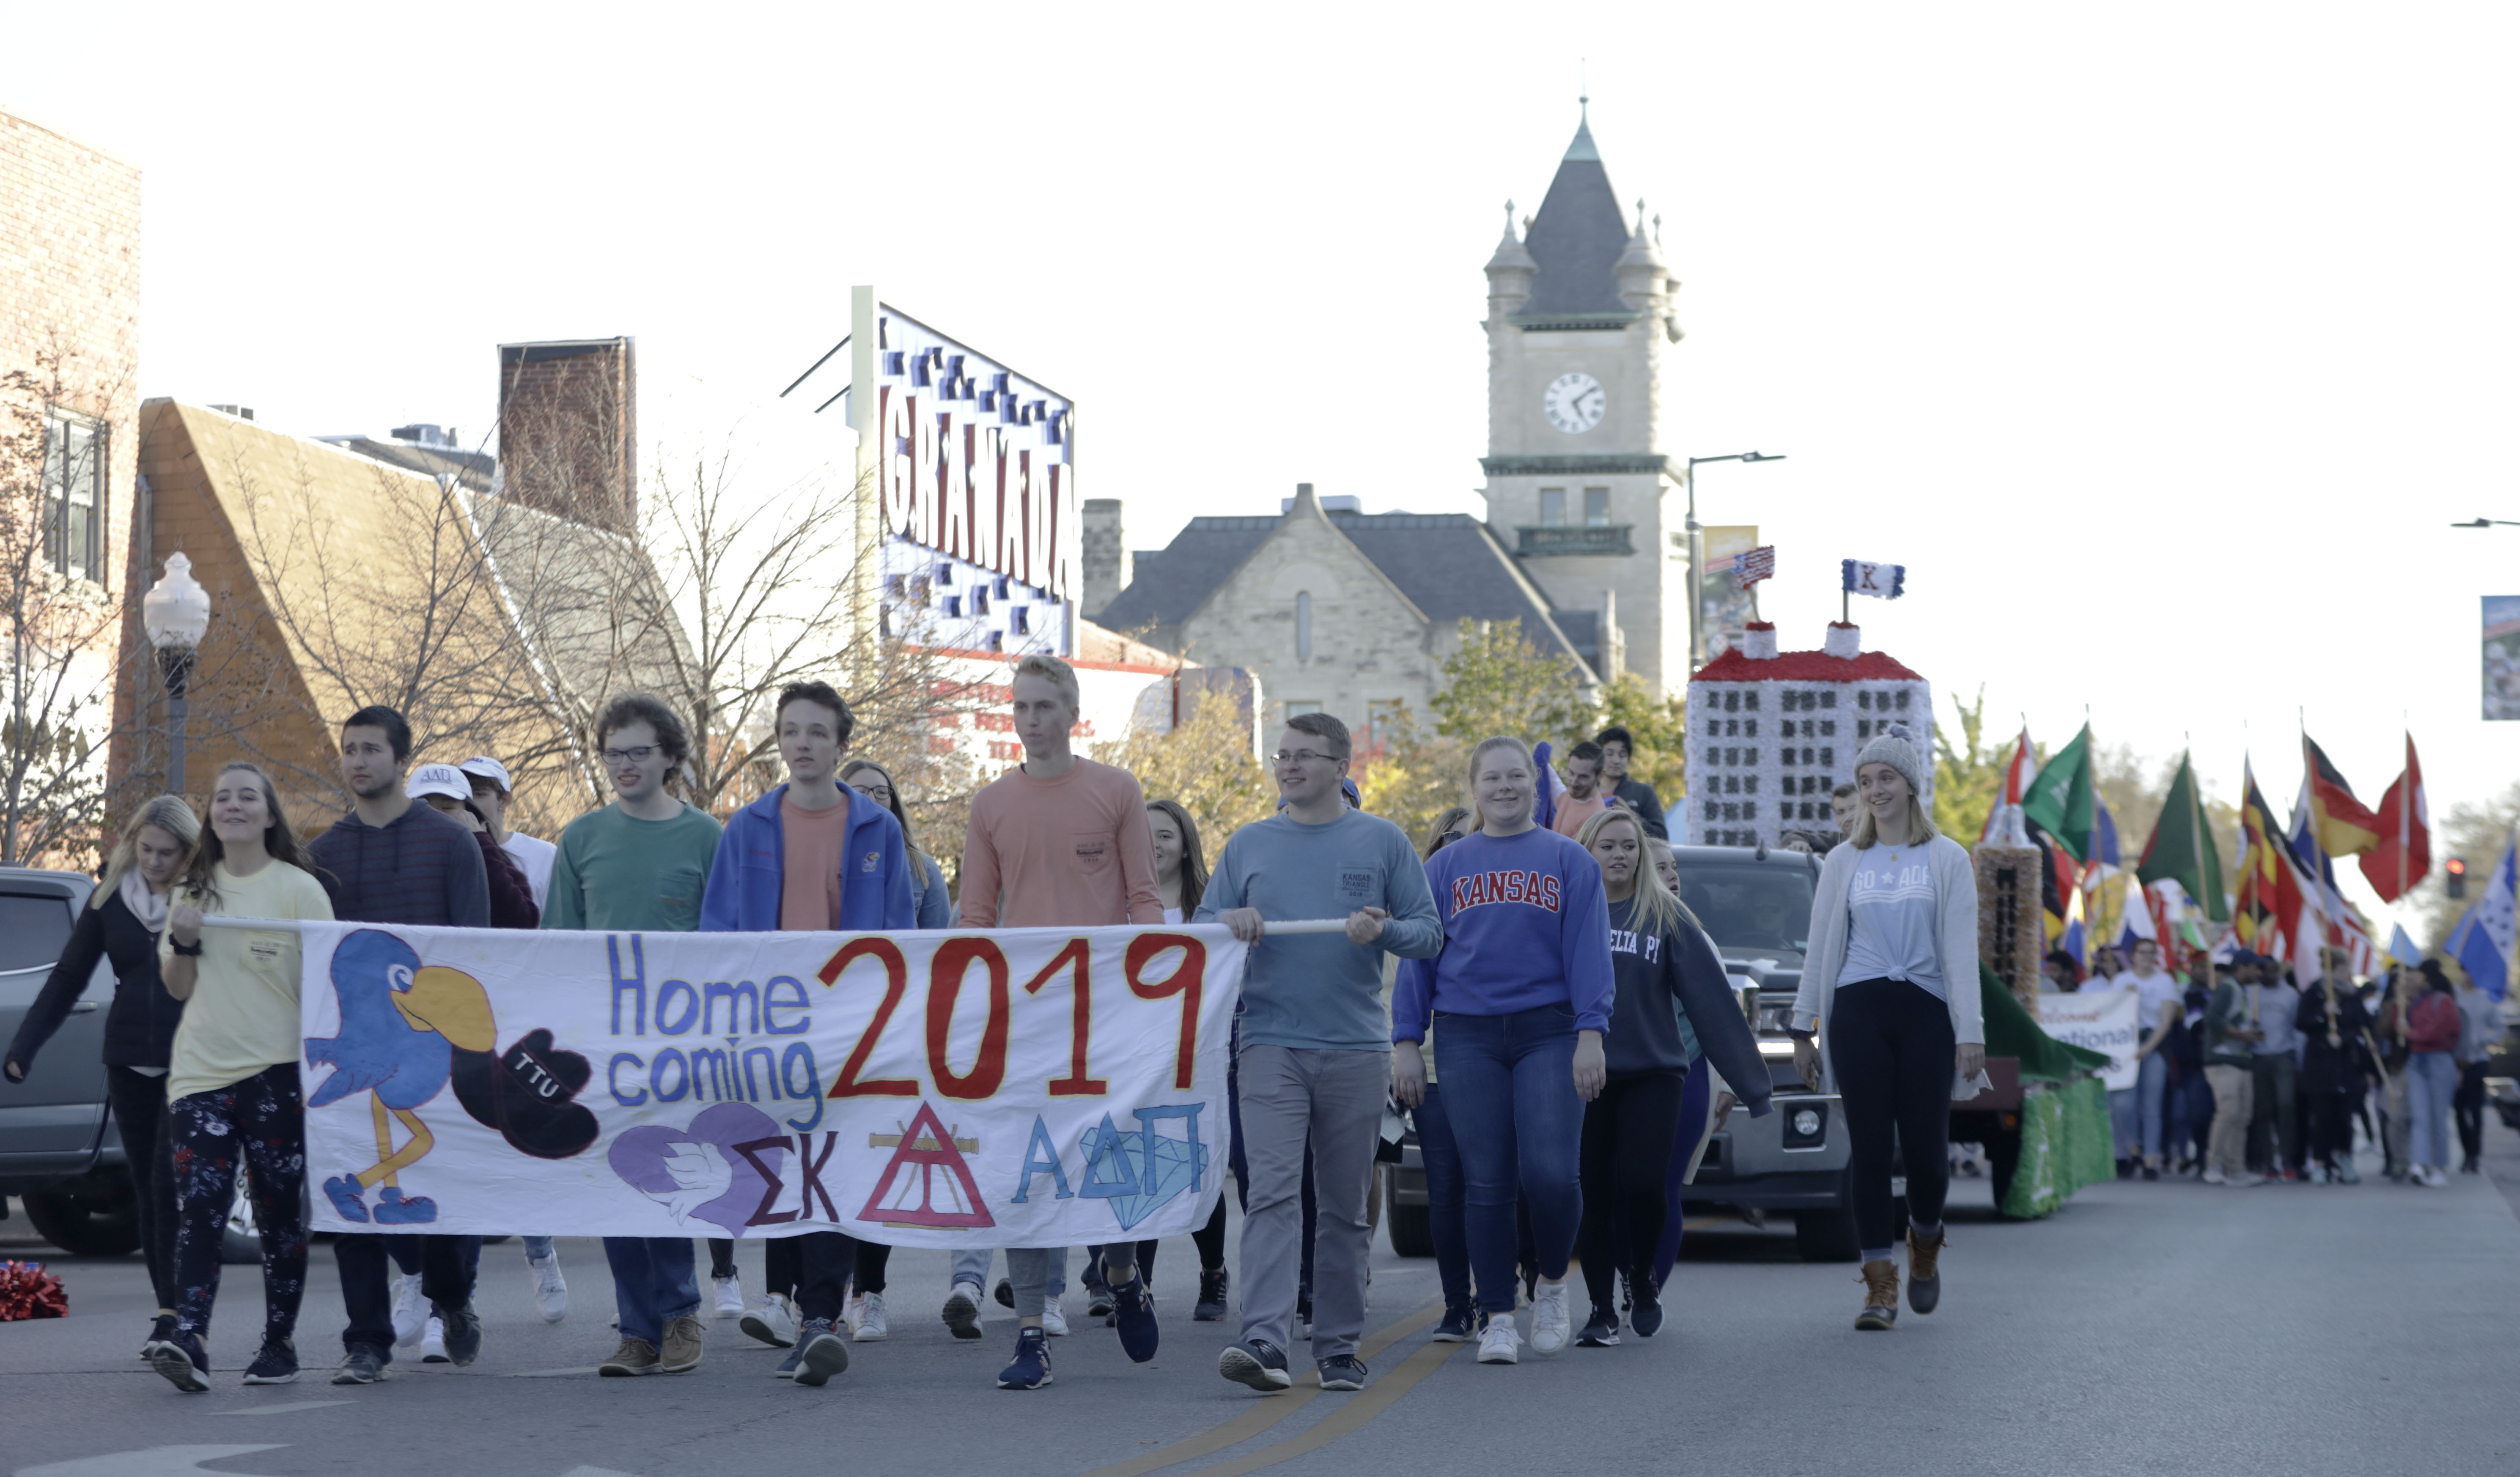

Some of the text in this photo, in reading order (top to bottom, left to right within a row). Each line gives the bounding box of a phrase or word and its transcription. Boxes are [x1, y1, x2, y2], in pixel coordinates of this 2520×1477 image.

[882, 384, 1082, 600] GRANADA
[1342, 873, 1371, 882] KANSAS
[1451, 870, 1560, 918] KANSAS
[1854, 869, 1876, 892] GO
[1611, 929, 1661, 965] ELTA PI
[607, 933, 811, 1037] Home
[816, 932, 1208, 1100] 2019
[513, 1051, 560, 1099] TTU
[608, 1037, 824, 1132] coming
